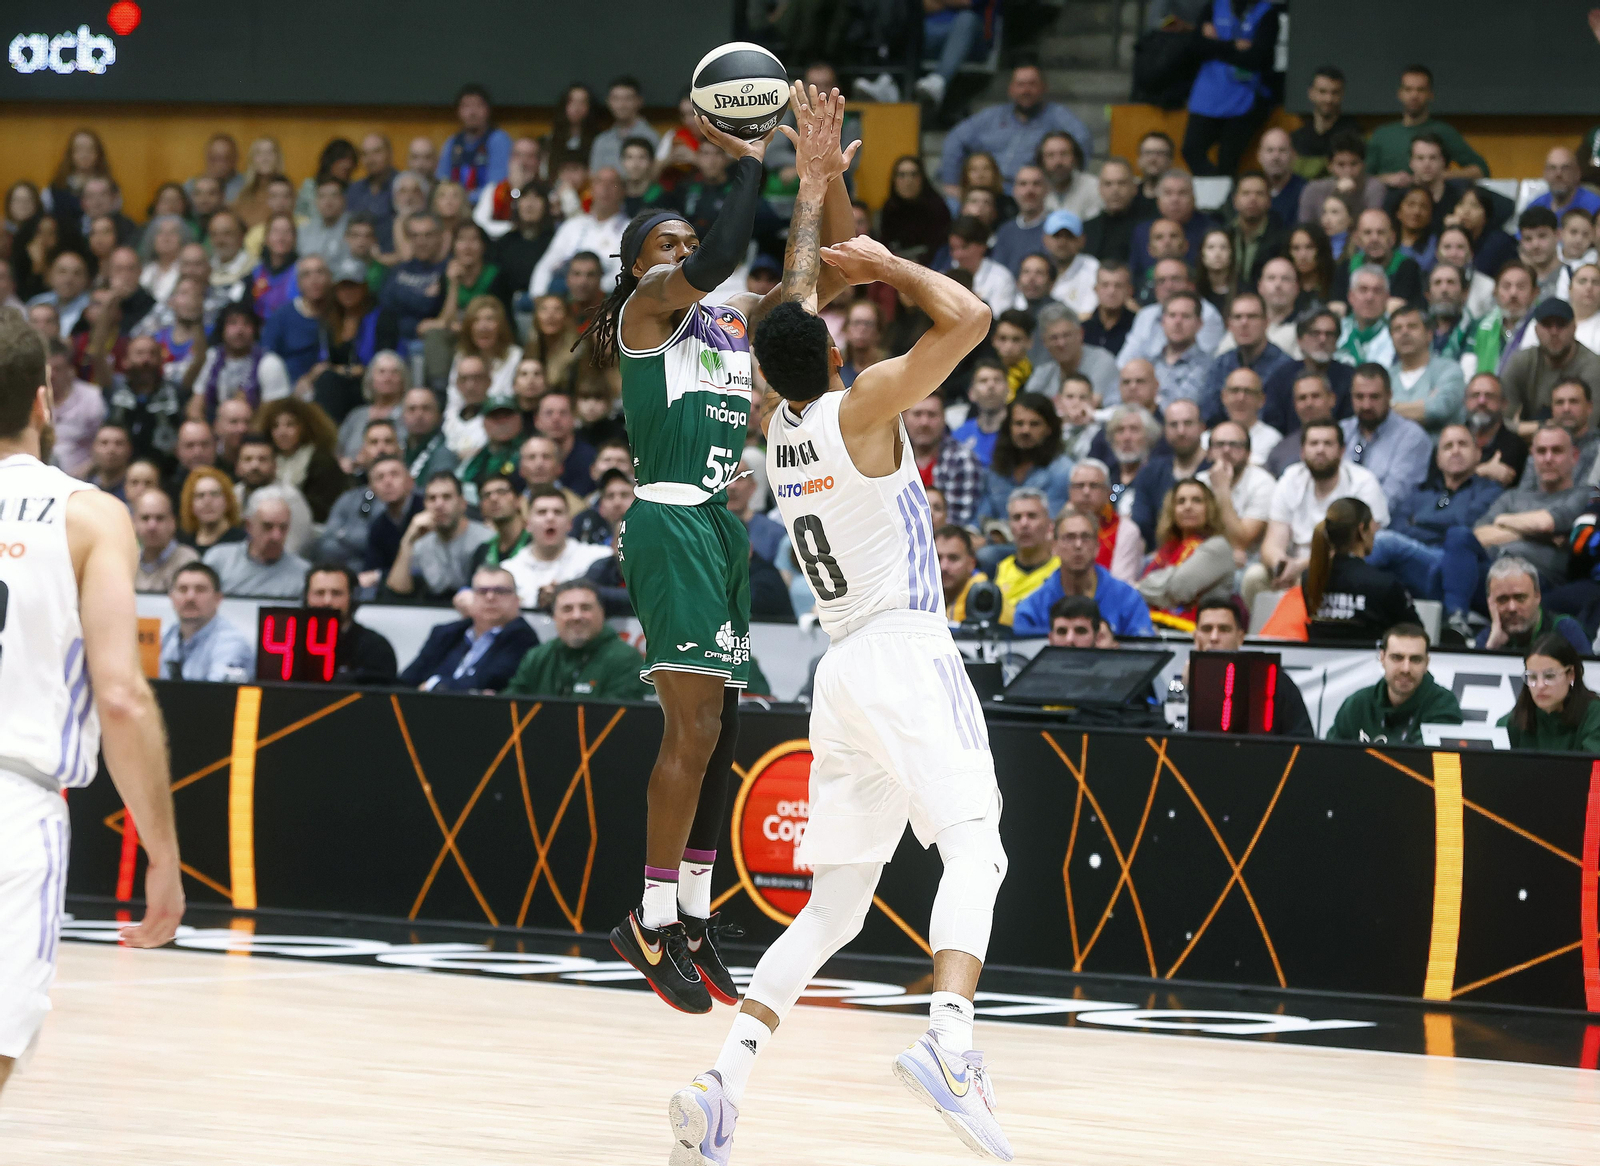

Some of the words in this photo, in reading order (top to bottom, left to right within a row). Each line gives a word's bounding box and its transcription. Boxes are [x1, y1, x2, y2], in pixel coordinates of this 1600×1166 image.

[8, 24, 116, 74] acb
[714, 89, 779, 109] SPALDING
[776, 439, 820, 468] HAGA
[778, 475, 835, 498] AUTOHERO
[793, 514, 848, 600] 8
[262, 614, 339, 682] 44
